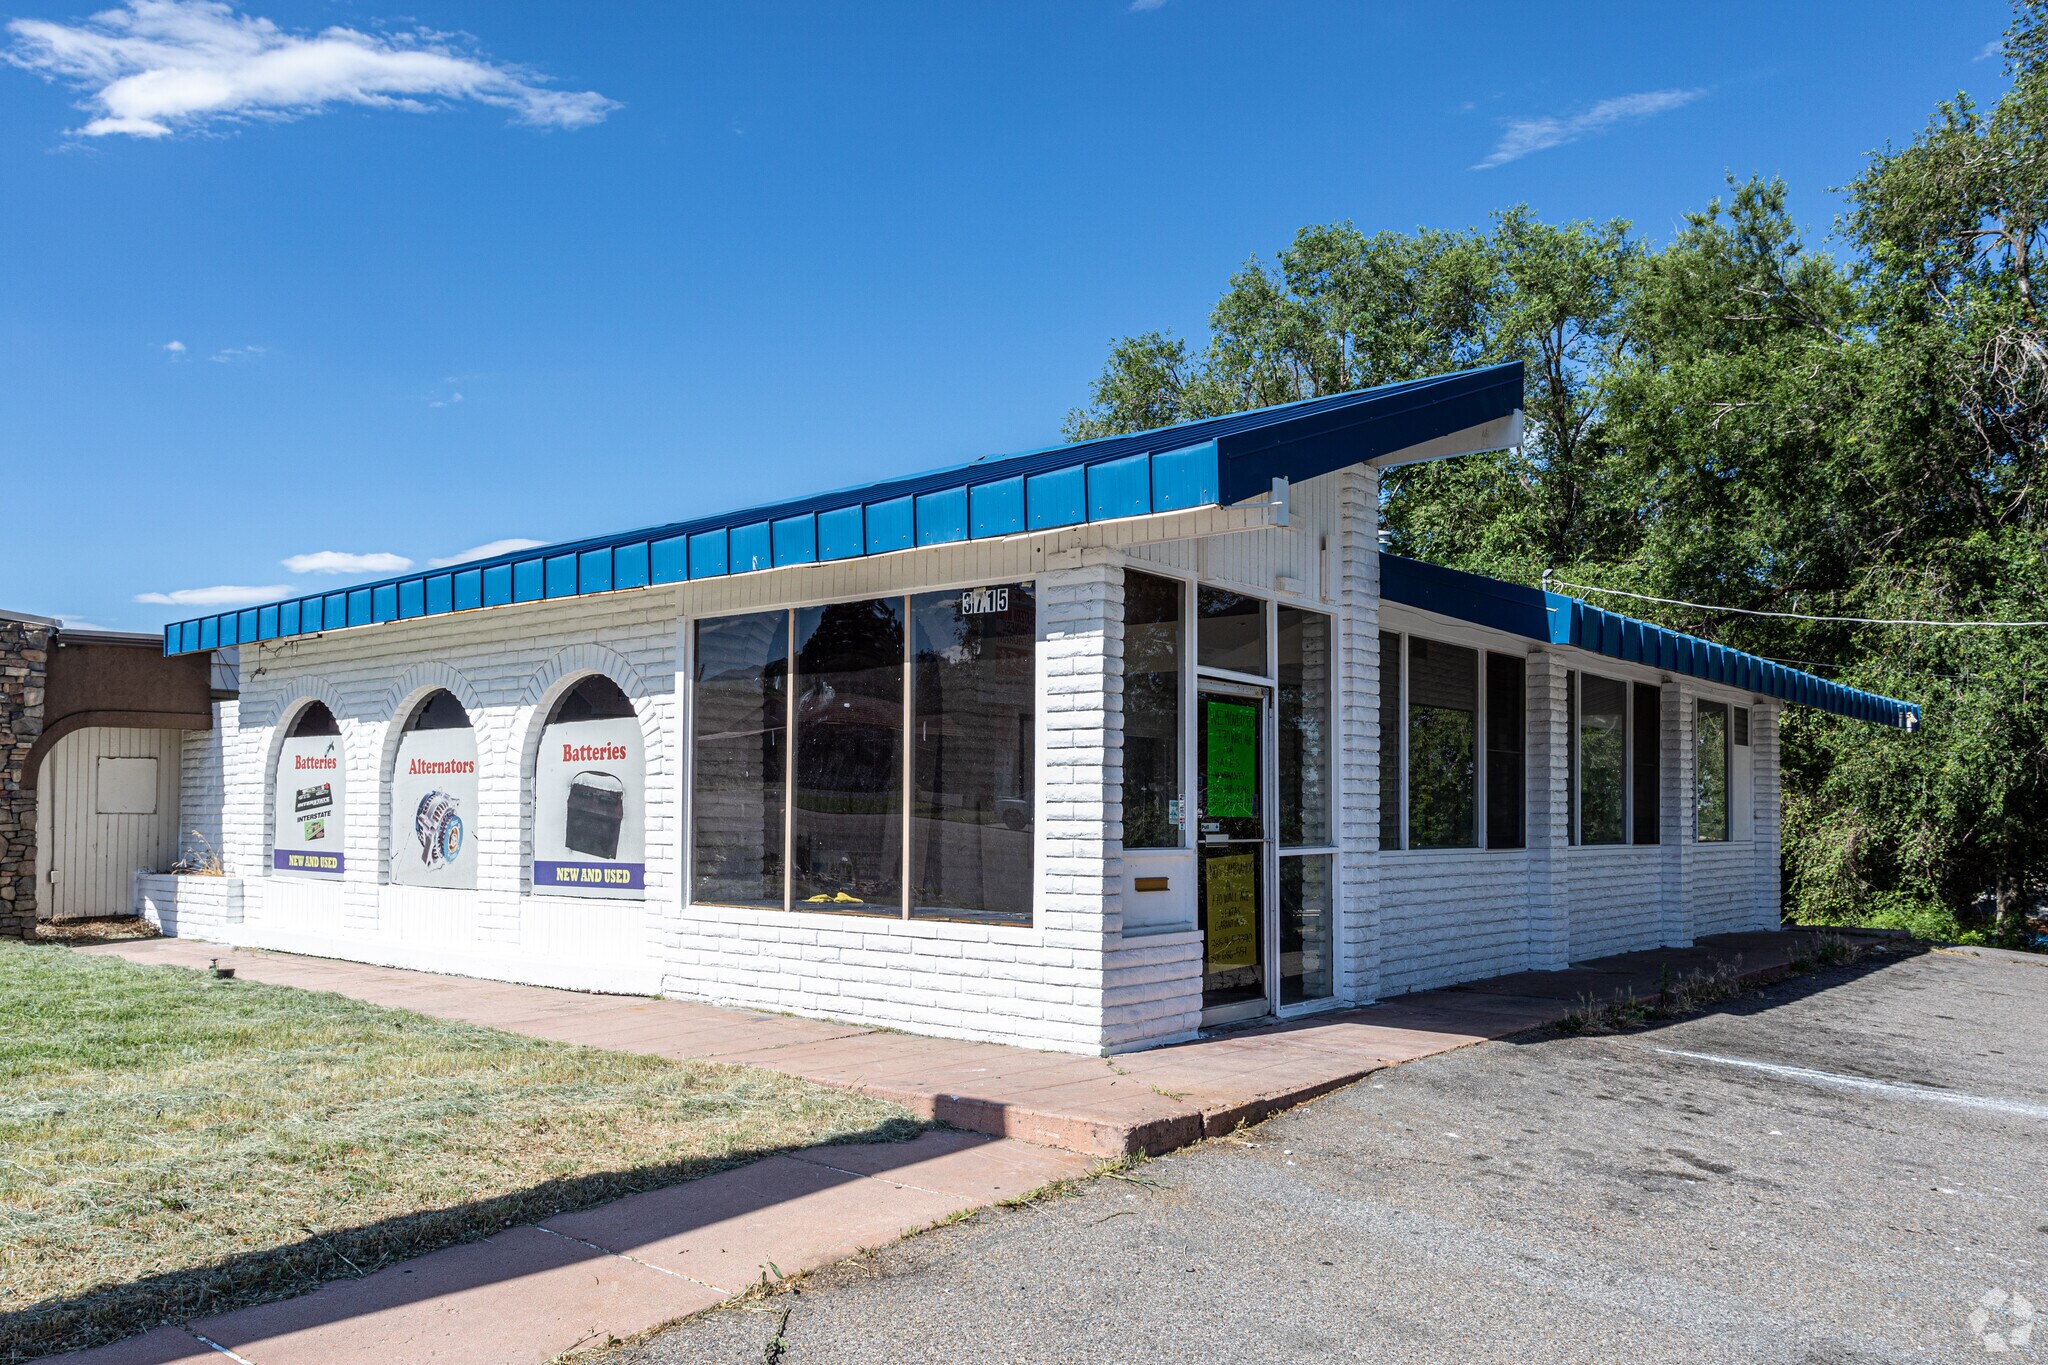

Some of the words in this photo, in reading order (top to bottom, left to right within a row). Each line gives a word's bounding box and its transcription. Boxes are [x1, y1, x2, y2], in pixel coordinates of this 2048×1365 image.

[964, 589, 1007, 613] 3715
[562, 741, 626, 762] Batteries
[295, 755, 336, 770] Batteries
[409, 758, 475, 774] Alternators
[297, 797, 330, 808] INTERSTATE
[296, 810, 332, 823] INTERSTATE
[289, 854, 304, 867] NEW
[305, 855, 319, 868] AND
[320, 856, 338, 869] USED
[556, 867, 579, 882] NEW
[581, 867, 602, 883] AND
[604, 868, 631, 884] USED
